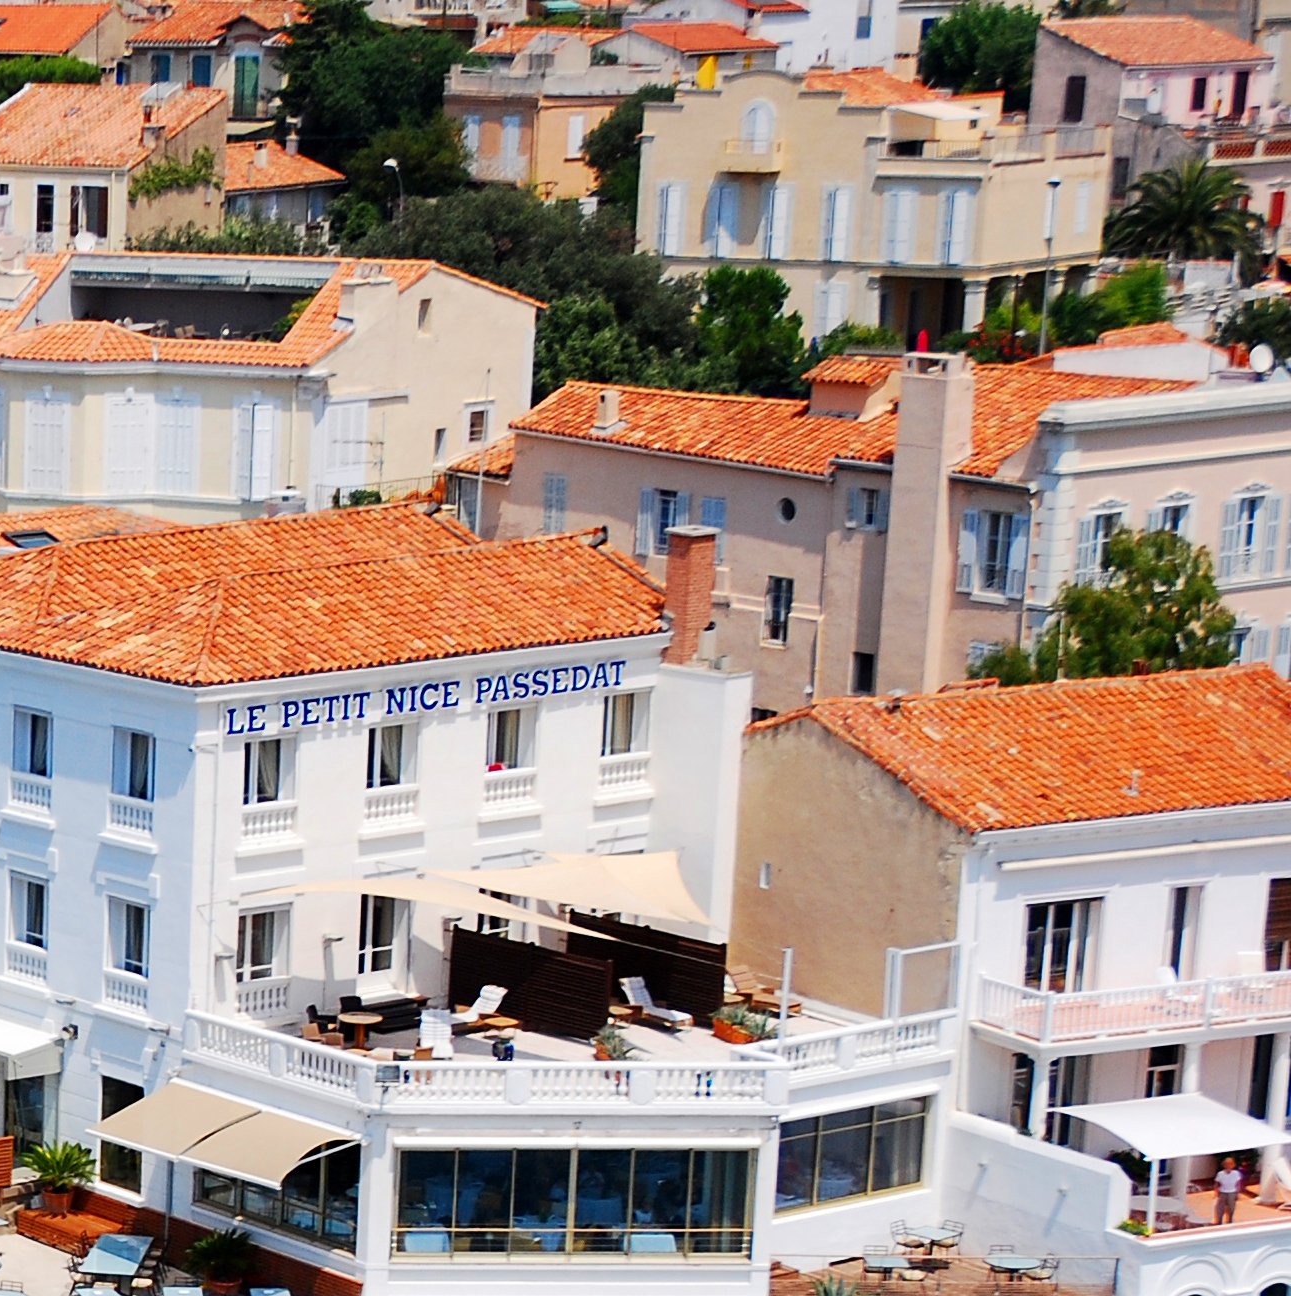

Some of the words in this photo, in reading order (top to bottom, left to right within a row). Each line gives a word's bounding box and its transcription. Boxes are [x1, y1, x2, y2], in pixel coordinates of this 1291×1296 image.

[226, 704, 267, 736] LE
[281, 690, 372, 731] PETIT
[385, 680, 461, 716] NICE
[475, 660, 628, 705] PASSEDAT
